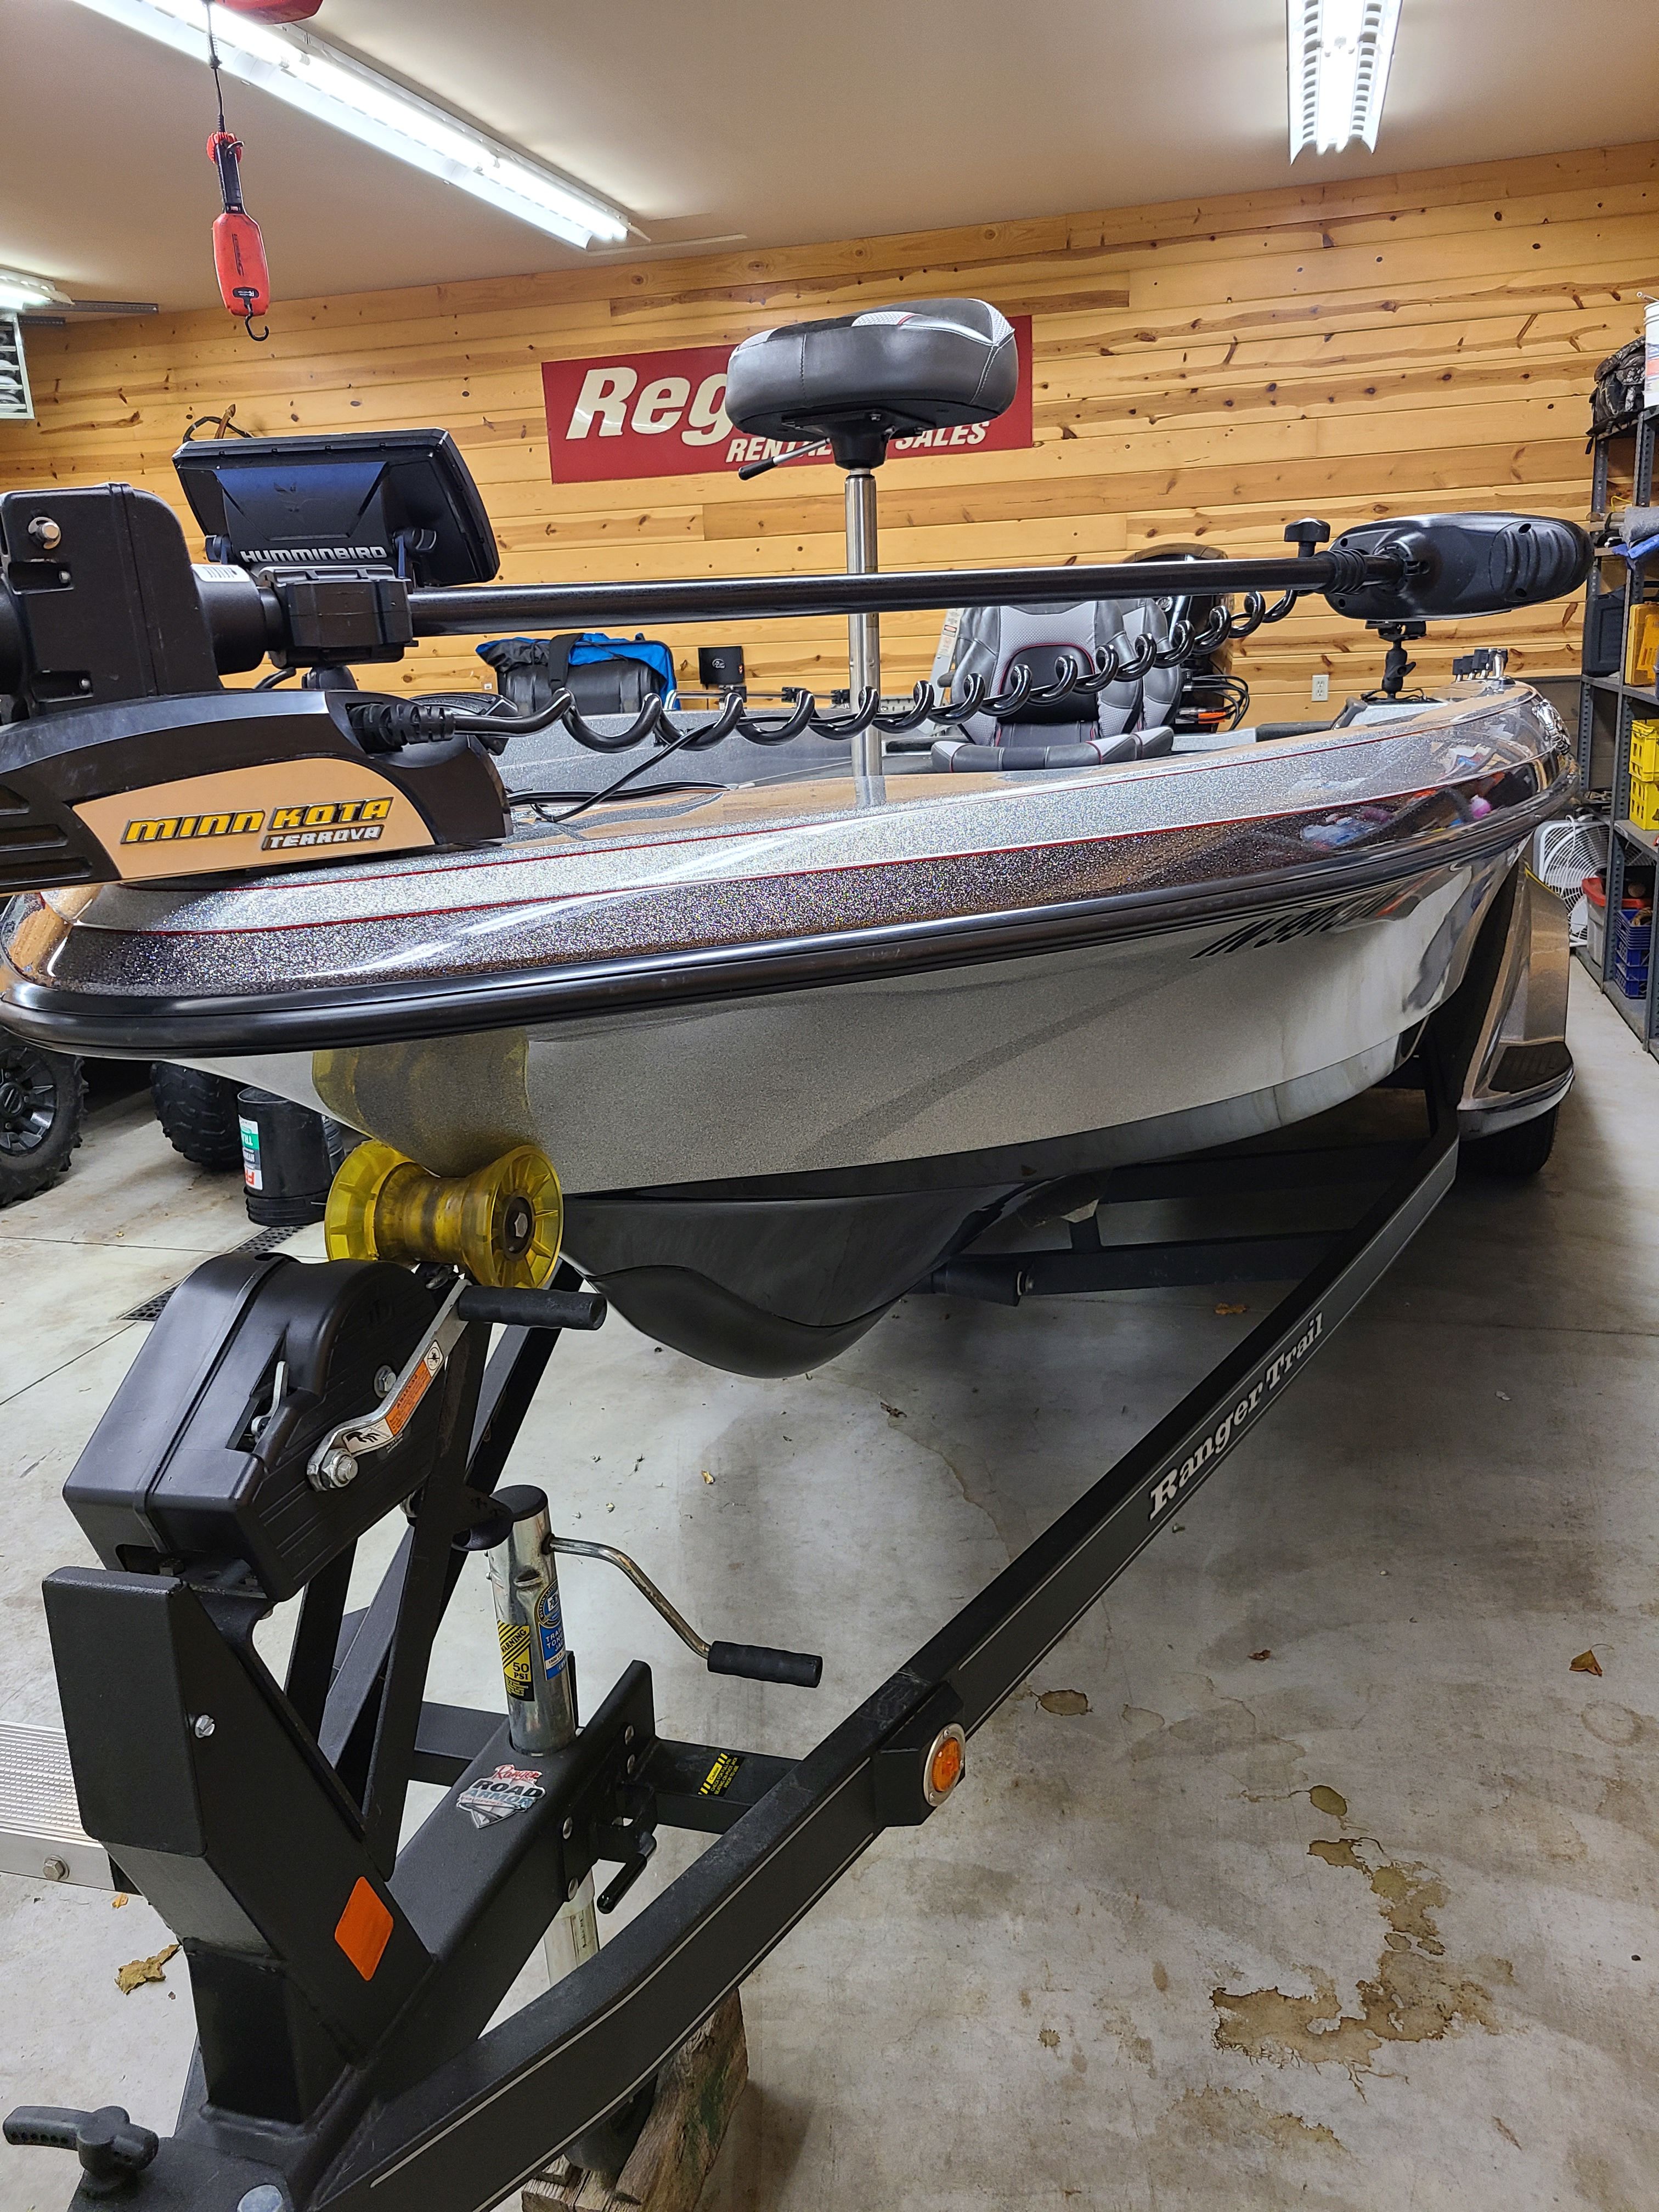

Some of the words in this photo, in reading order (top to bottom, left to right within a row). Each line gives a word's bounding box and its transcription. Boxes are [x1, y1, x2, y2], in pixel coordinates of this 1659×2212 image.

[565, 366, 733, 446] Reg
[240, 546, 387, 562] HUMMINBIRD
[120, 809, 266, 844] MINN
[268, 797, 394, 831] KOTA
[264, 825, 386, 850] TERROVA
[1149, 1381, 1263, 1521] Ranger
[1266, 1312, 1323, 1390] Trail
[501, 1629, 527, 1654] WARNING
[512, 1662, 529, 1673] 50
[493, 1767, 540, 1780] Ranger
[467, 1790, 534, 1808] ARMOR
[472, 1780, 543, 1797] ROAD
